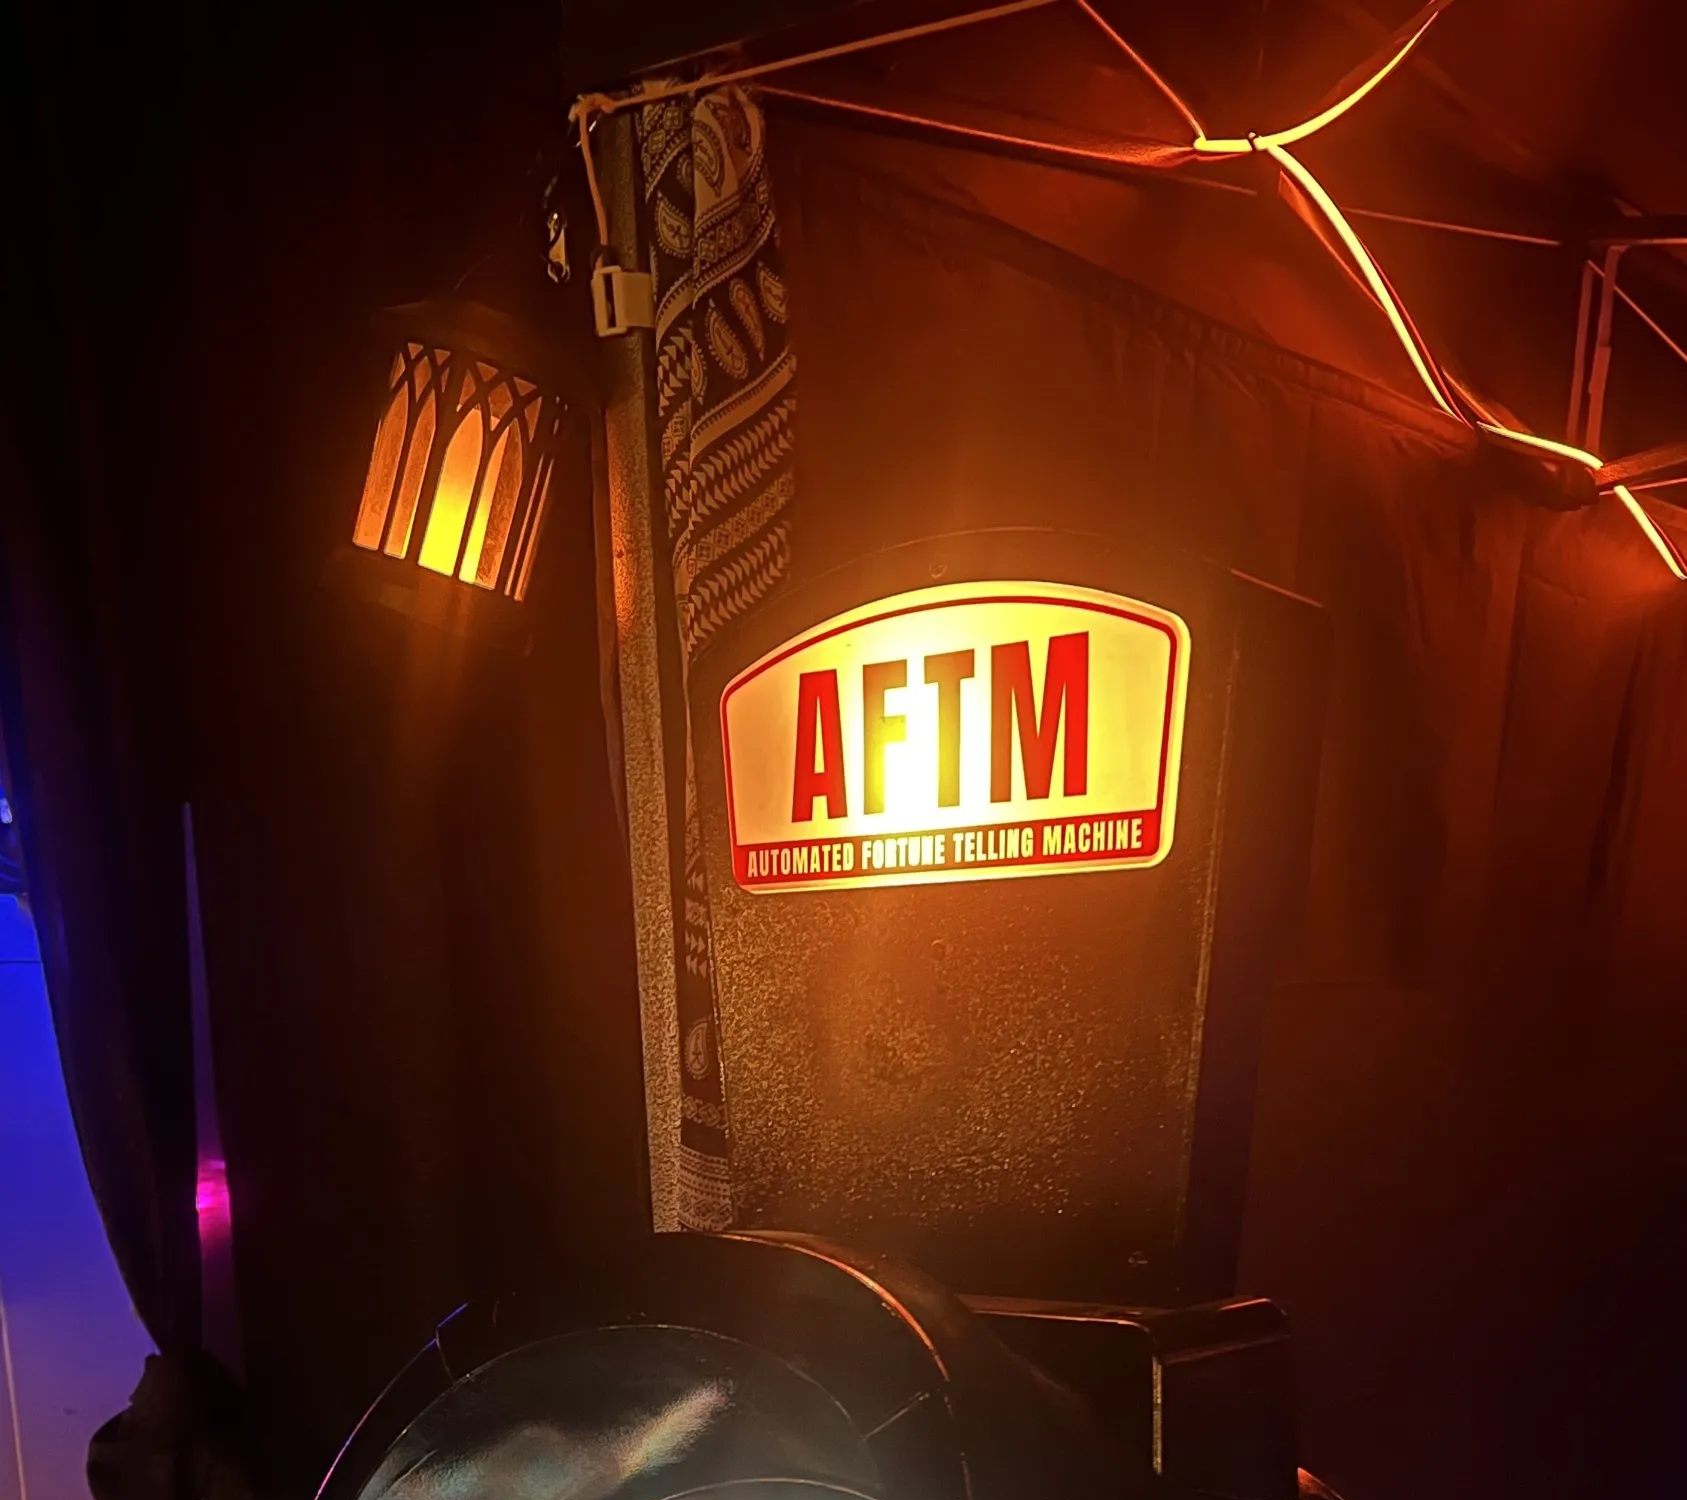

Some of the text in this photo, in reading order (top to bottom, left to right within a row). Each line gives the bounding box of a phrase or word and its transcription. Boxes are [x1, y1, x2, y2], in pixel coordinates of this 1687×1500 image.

[791, 630, 1089, 823] AFTM
[747, 818, 1143, 878] AUTOMATED FORTUNE TELLING MACHINE
